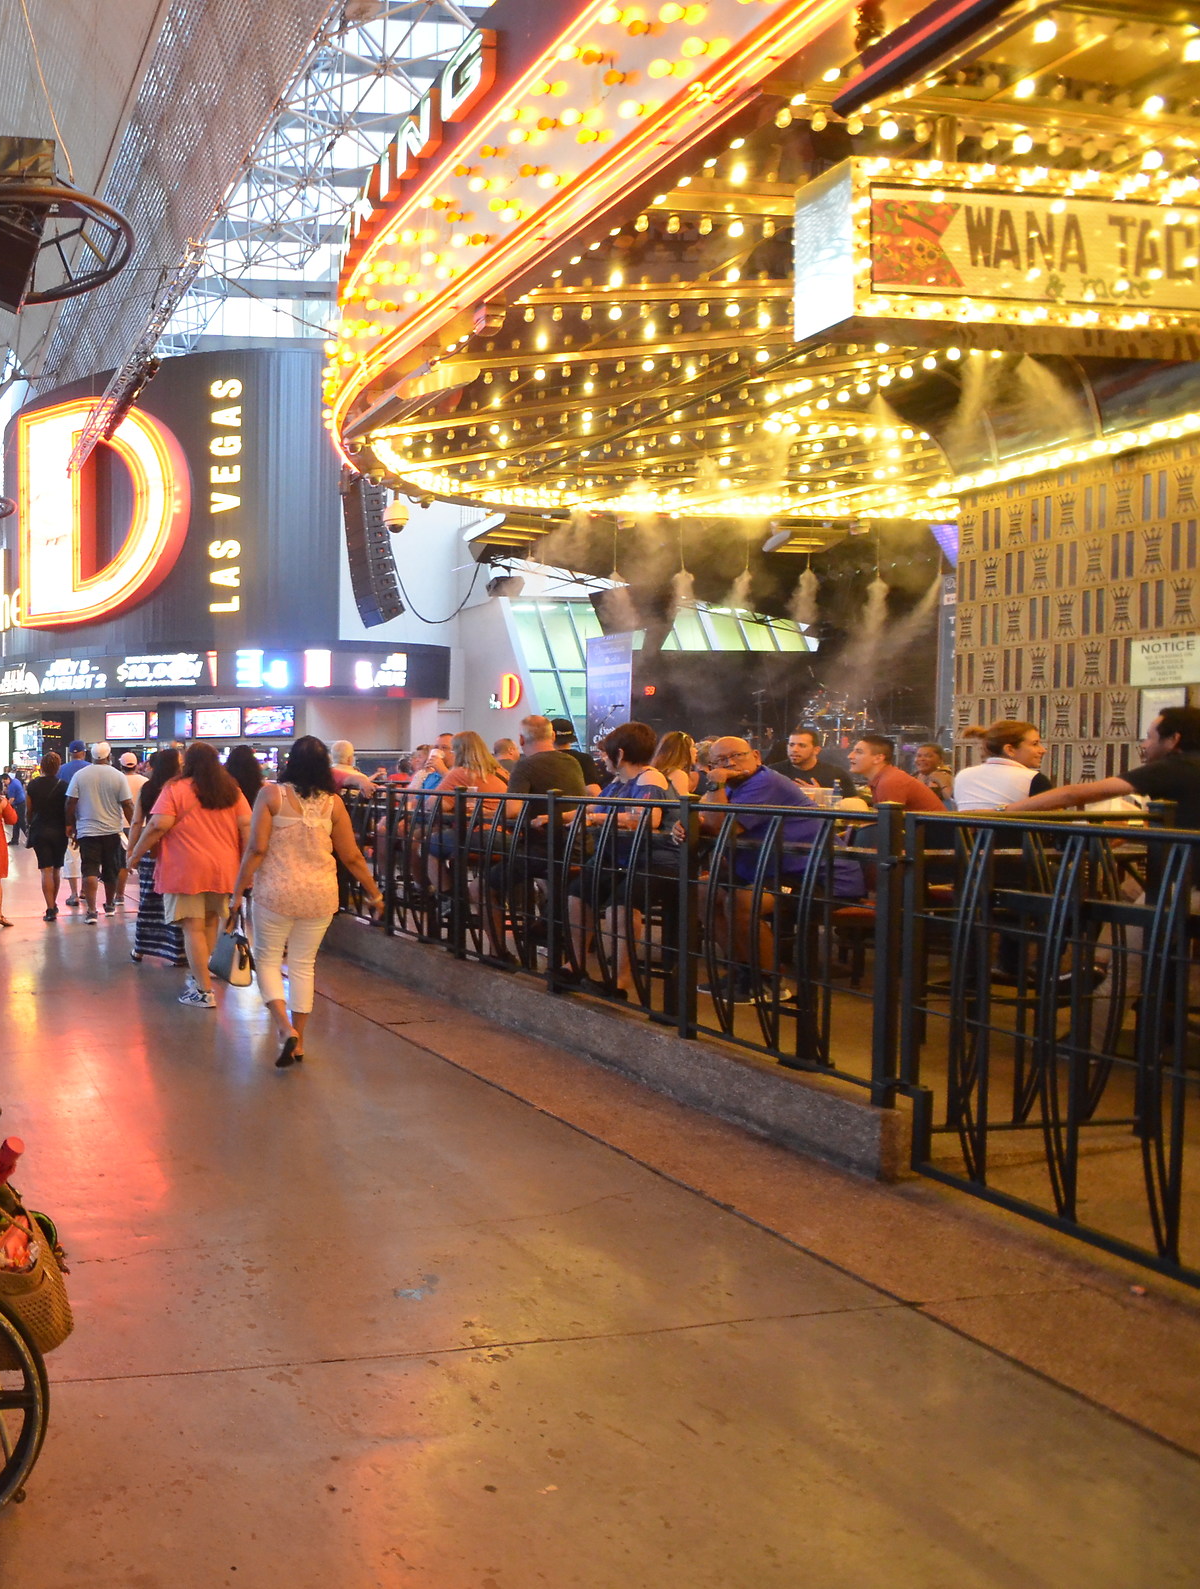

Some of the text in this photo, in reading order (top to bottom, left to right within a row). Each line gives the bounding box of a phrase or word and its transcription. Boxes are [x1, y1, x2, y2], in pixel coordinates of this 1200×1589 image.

[964, 204, 1200, 281] WANA TAC
[19, 397, 189, 629] D
[209, 377, 244, 613] LAS VEGAS
[1140, 640, 1195, 654] NOTICE
[41, 674, 95, 693] AUGUST
[95, 674, 107, 688] 2
[501, 673, 521, 709] D
